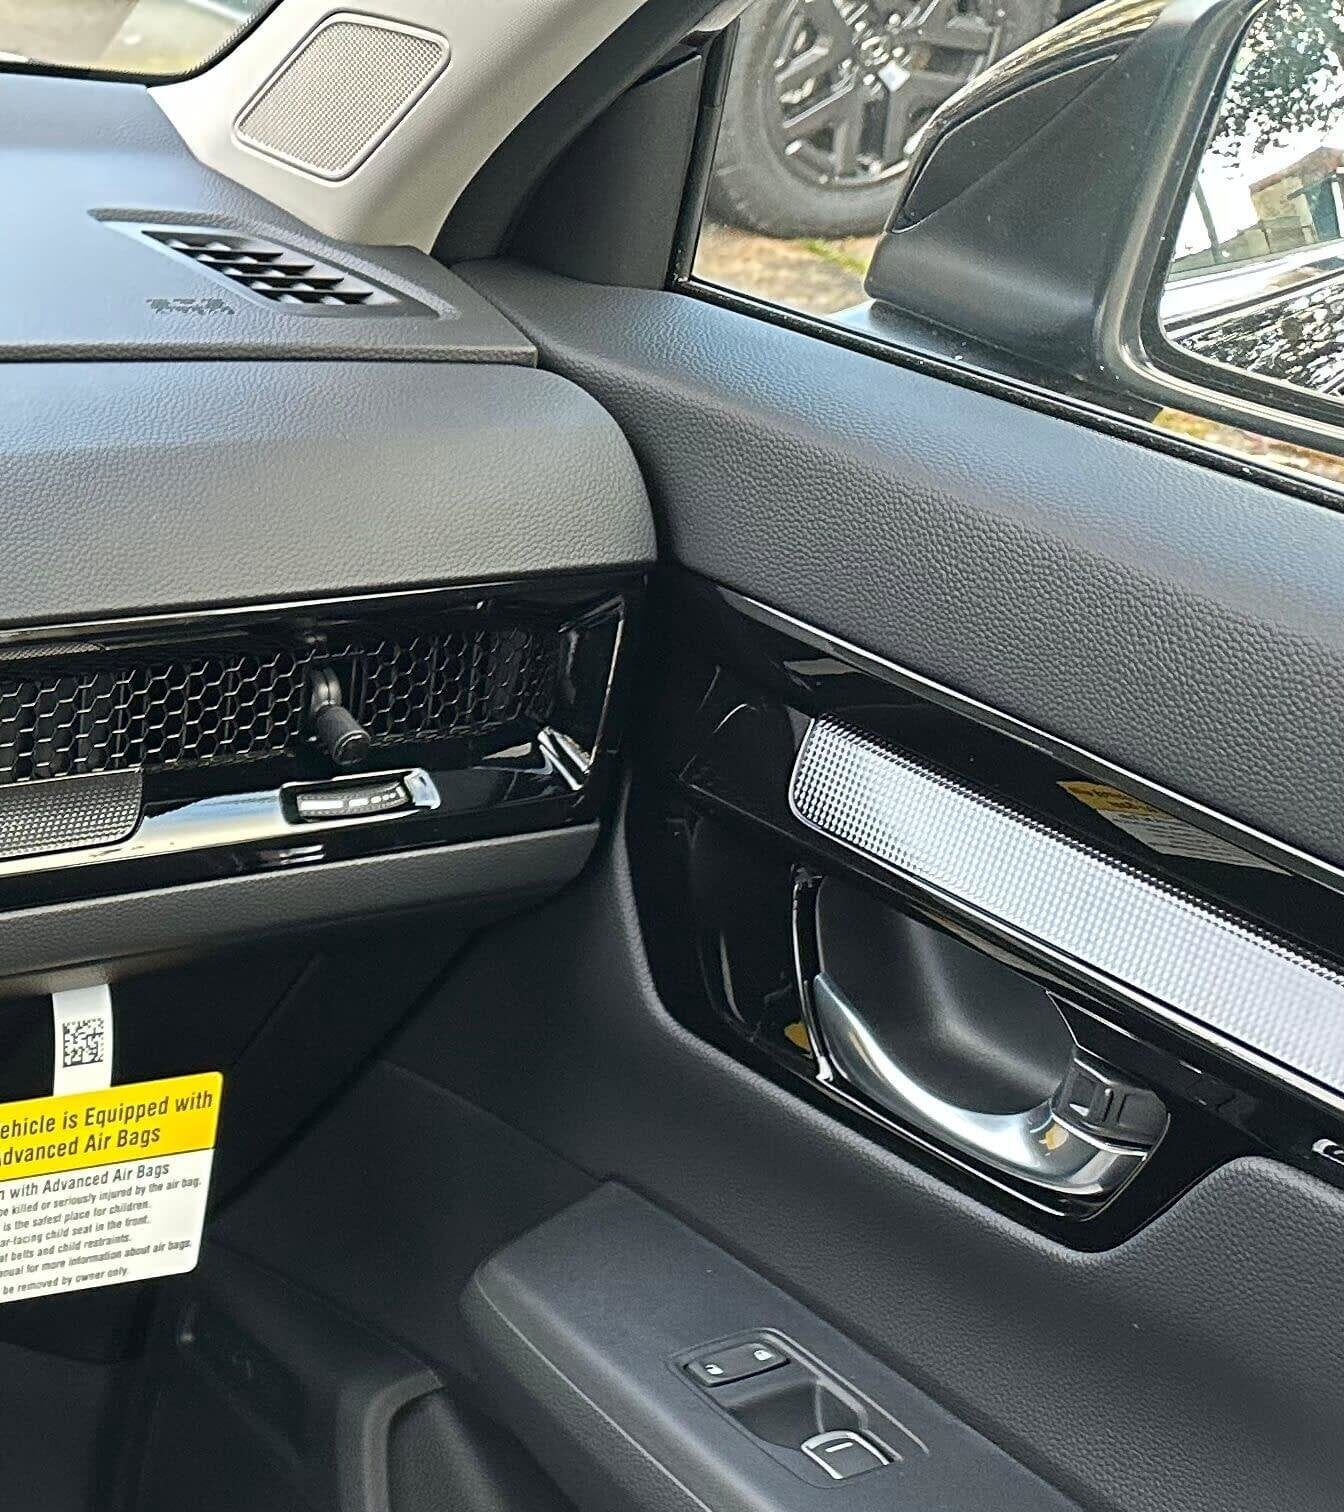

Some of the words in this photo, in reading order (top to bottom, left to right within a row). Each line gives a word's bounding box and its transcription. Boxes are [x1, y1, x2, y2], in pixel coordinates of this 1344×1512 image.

[62, 1110, 78, 1130] is
[84, 1095, 170, 1128] Equipped
[175, 1090, 213, 1112] with
[84, 1132, 112, 1153] Air
[117, 1127, 161, 1148] Bags
[10, 1183, 38, 1198] with
[42, 1171, 109, 1194] Advanced
[112, 1168, 133, 1183] Air
[137, 1163, 170, 1179] Bags
[12, 1201, 38, 1214] killed
[41, 1201, 51, 1210] or
[53, 1193, 97, 1208] seriously
[99, 1187, 132, 1201] injured
[135, 1185, 146, 1196] by
[149, 1182, 163, 1193] the
[166, 1180, 179, 1190] air
[3, 1222, 12, 1231] is
[14, 1220, 30, 1230] the
[32, 1213, 63, 1227] safest
[64, 1210, 90, 1224] place
[93, 1207, 107, 1217] for
[46, 1227, 70, 1240] child
[72, 1224, 93, 1236] seat
[95, 1222, 104, 1232] in
[107, 1220, 122, 1230] the
[11, 1249, 34, 1261] belts
[37, 1245, 55, 1257] and
[58, 1241, 81, 1254] child
[26, 1263, 39, 1273] for
[124, 1245, 151, 1257] about
[153, 1242, 166, 1253] air
[2, 1285, 14, 1294] be
[18, 1277, 59, 1292] removed
[61, 1276, 73, 1287] by
[75, 1271, 105, 1283] owner
